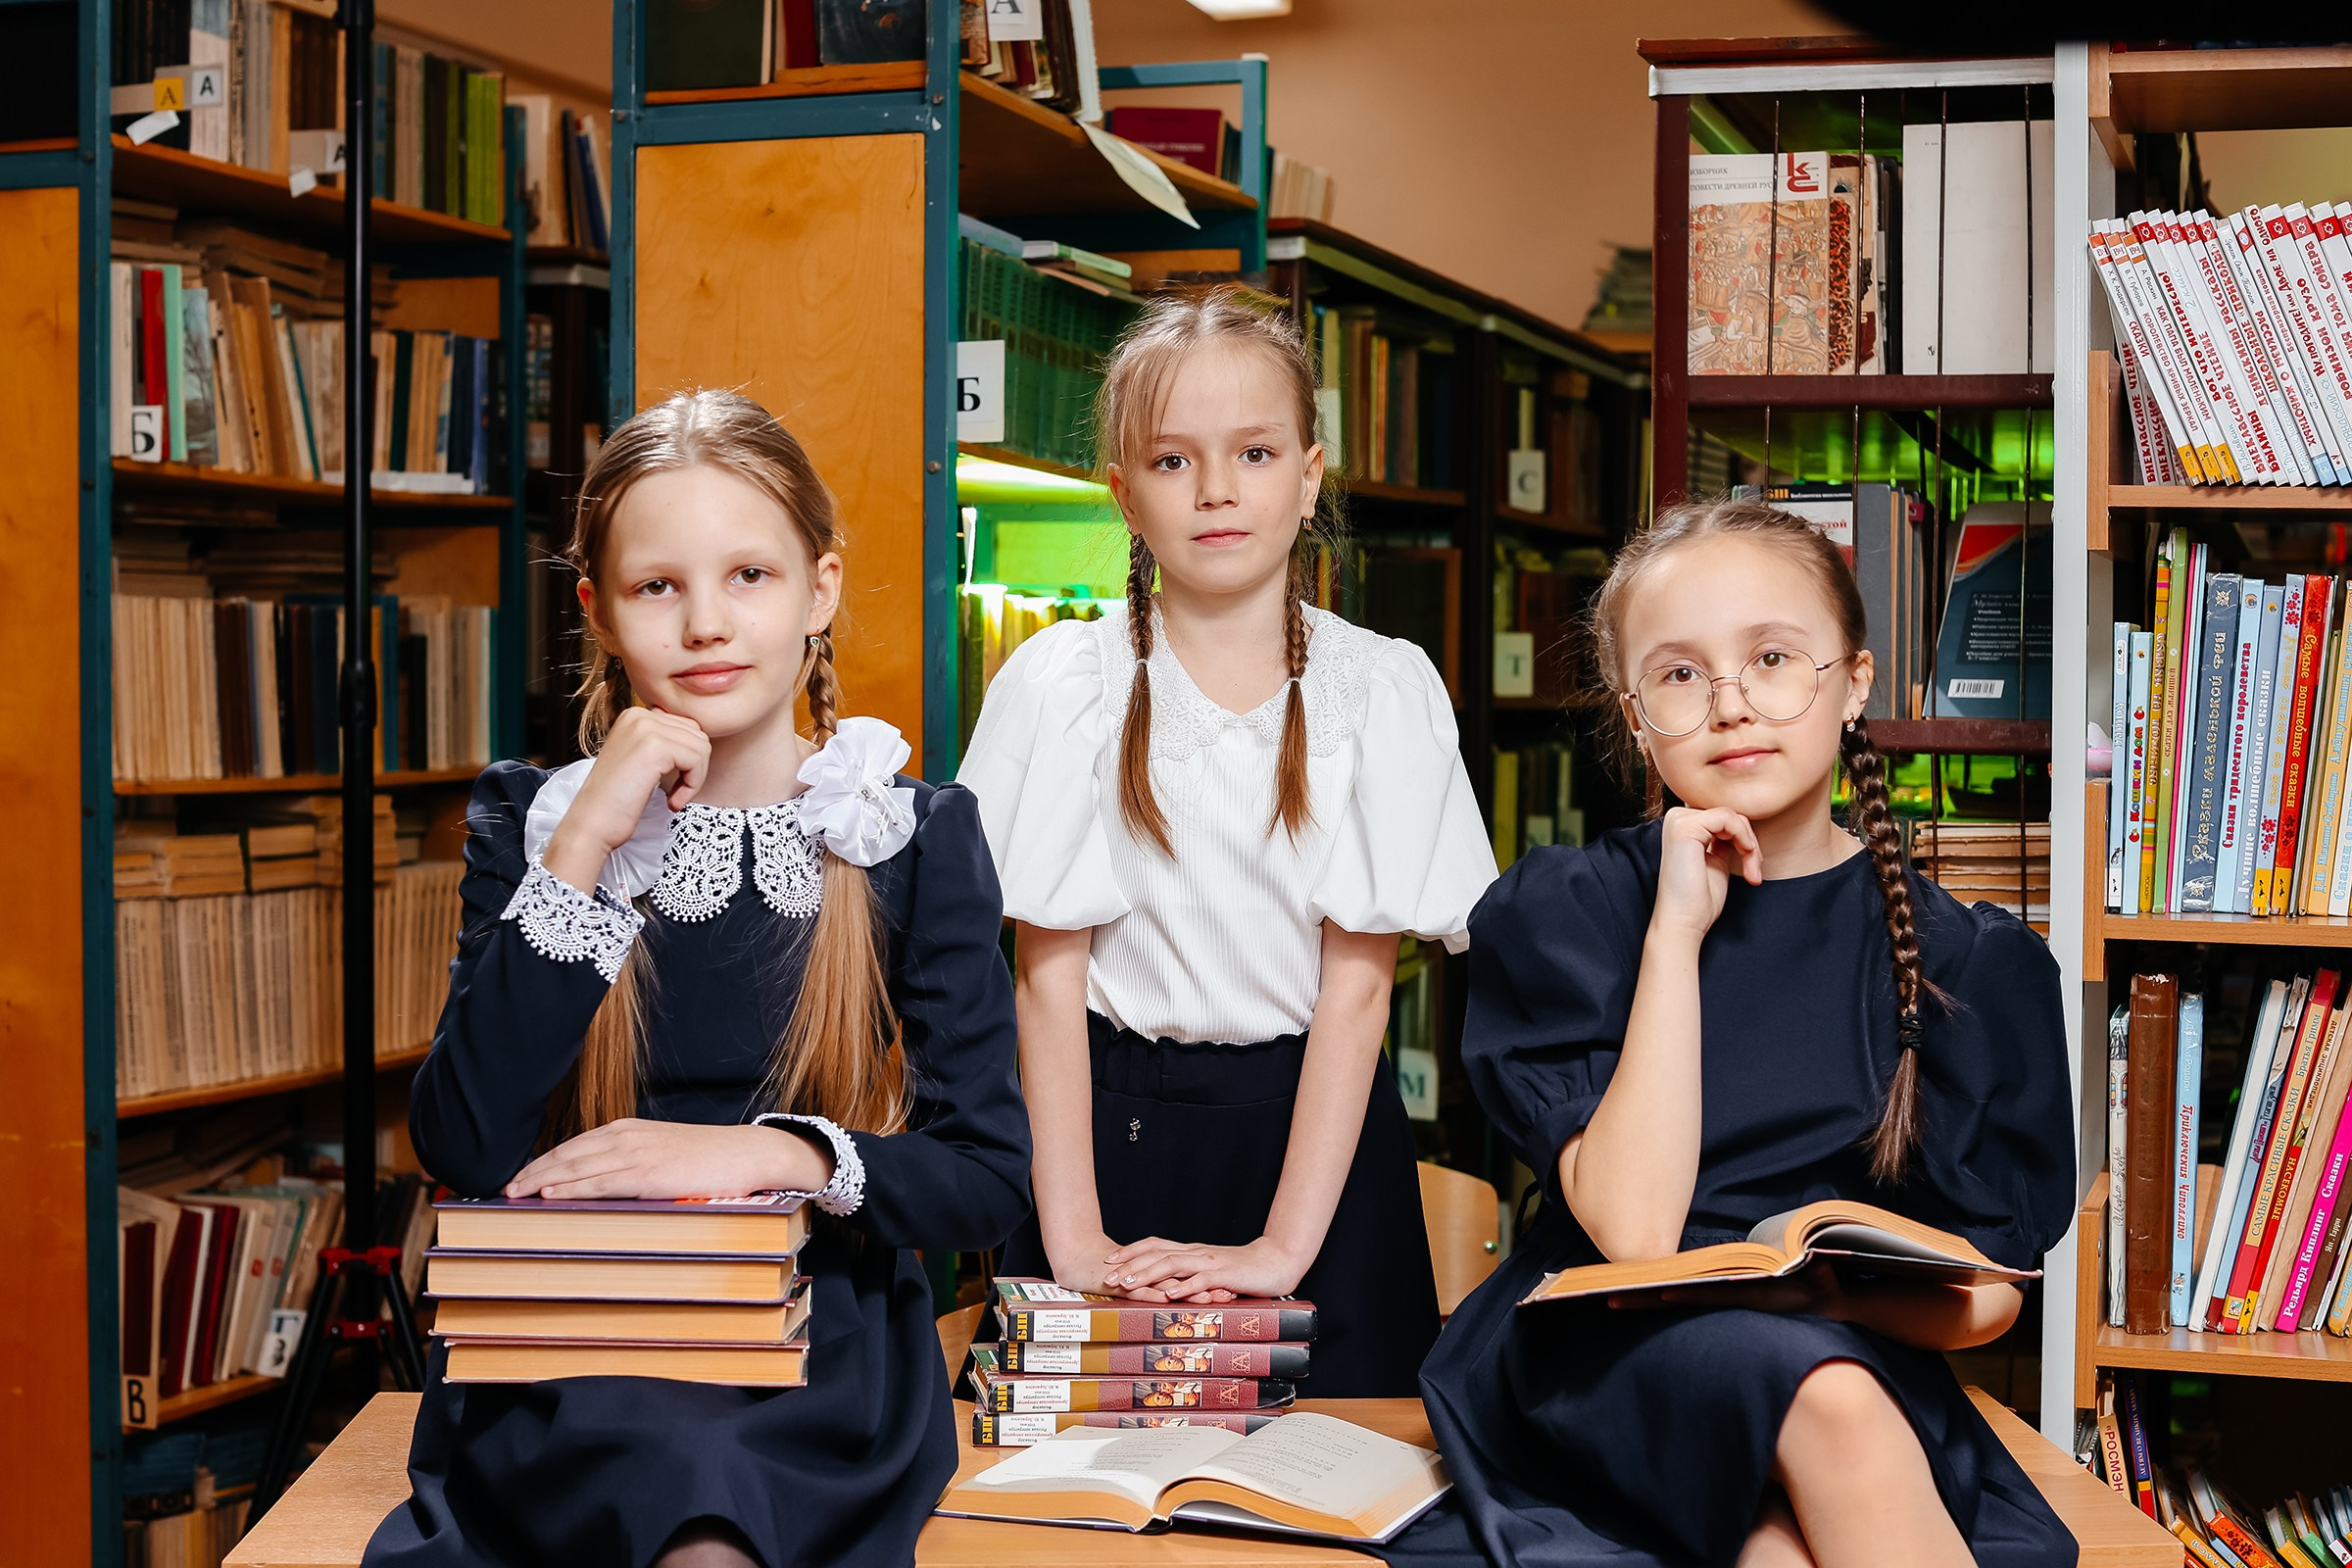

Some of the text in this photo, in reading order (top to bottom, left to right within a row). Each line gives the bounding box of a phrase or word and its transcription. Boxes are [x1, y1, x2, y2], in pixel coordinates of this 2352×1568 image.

[161, 87, 177, 107] А
[200, 75, 214, 96] А
[2130, 280, 2144, 308] Губарев
[2145, 277, 2158, 300] Раскин
[2305, 241, 2331, 290] СОЙЕРА
[2114, 285, 2131, 316] Андерсен
[2255, 269, 2295, 354] Беспризорная кошка
[2297, 278, 2322, 322] КРУЗО
[2327, 293, 2347, 329] ТОМА
[2129, 320, 2150, 359] СКАЗКИ
[2156, 305, 2212, 421] КАК ПАПА БЫЛ МАЛЕНЬКИМ
[2158, 270, 2222, 402] ВОТ ЧТО ИНТЕРЕСНО!
[2198, 331, 2226, 381] ЧТЕНИЕ
[2241, 319, 2278, 393] ШКОЛЬНЫЕ
[2317, 326, 2352, 401] РОБИНЗОН
[957, 377, 981, 412] Б
[2142, 312, 2199, 432] КОРОЛЕВСТВО КРИВЫХ ЗЕРКАЛ
[2229, 327, 2269, 407] ДЕНИСКИНЫ
[2255, 310, 2317, 447] РАССКАЗЫ О ЖИВОТНЫХ
[132, 412, 155, 454] Б
[2247, 410, 2280, 473] БЫЛИНЫ
[1518, 470, 1540, 494] С
[1506, 654, 1528, 676] Т
[2222, 643, 2251, 849] Сказки тридесятого королевства
[2268, 634, 2297, 806] Лучшие сказки на ночь
[2285, 633, 2317, 808] Самые волшебные сказки
[2237, 669, 2272, 900] Лучшие волшебные сказки
[2333, 845, 2352, 900] Сказки
[2183, 1059, 2193, 1092] Родари
[2295, 1014, 2322, 1078] Братья Гримм
[2306, 1020, 2337, 1109] ДЕТСКАЯ ЭНЦИКЛОПЕДИЯ
[2176, 1103, 2194, 1240] Приключения Чиполлино
[2251, 1087, 2300, 1237] САМЫЕ КРАСИВЫЕ СКАЗКИ
[2271, 1156, 2296, 1221] НАСЕКОМЫЕ
[2321, 1152, 2344, 1199] Сказки
[2282, 1208, 2327, 1318] Редьярд Киплинг
[2324, 1241, 2333, 1253] Ян
[127, 1380, 146, 1424] В
